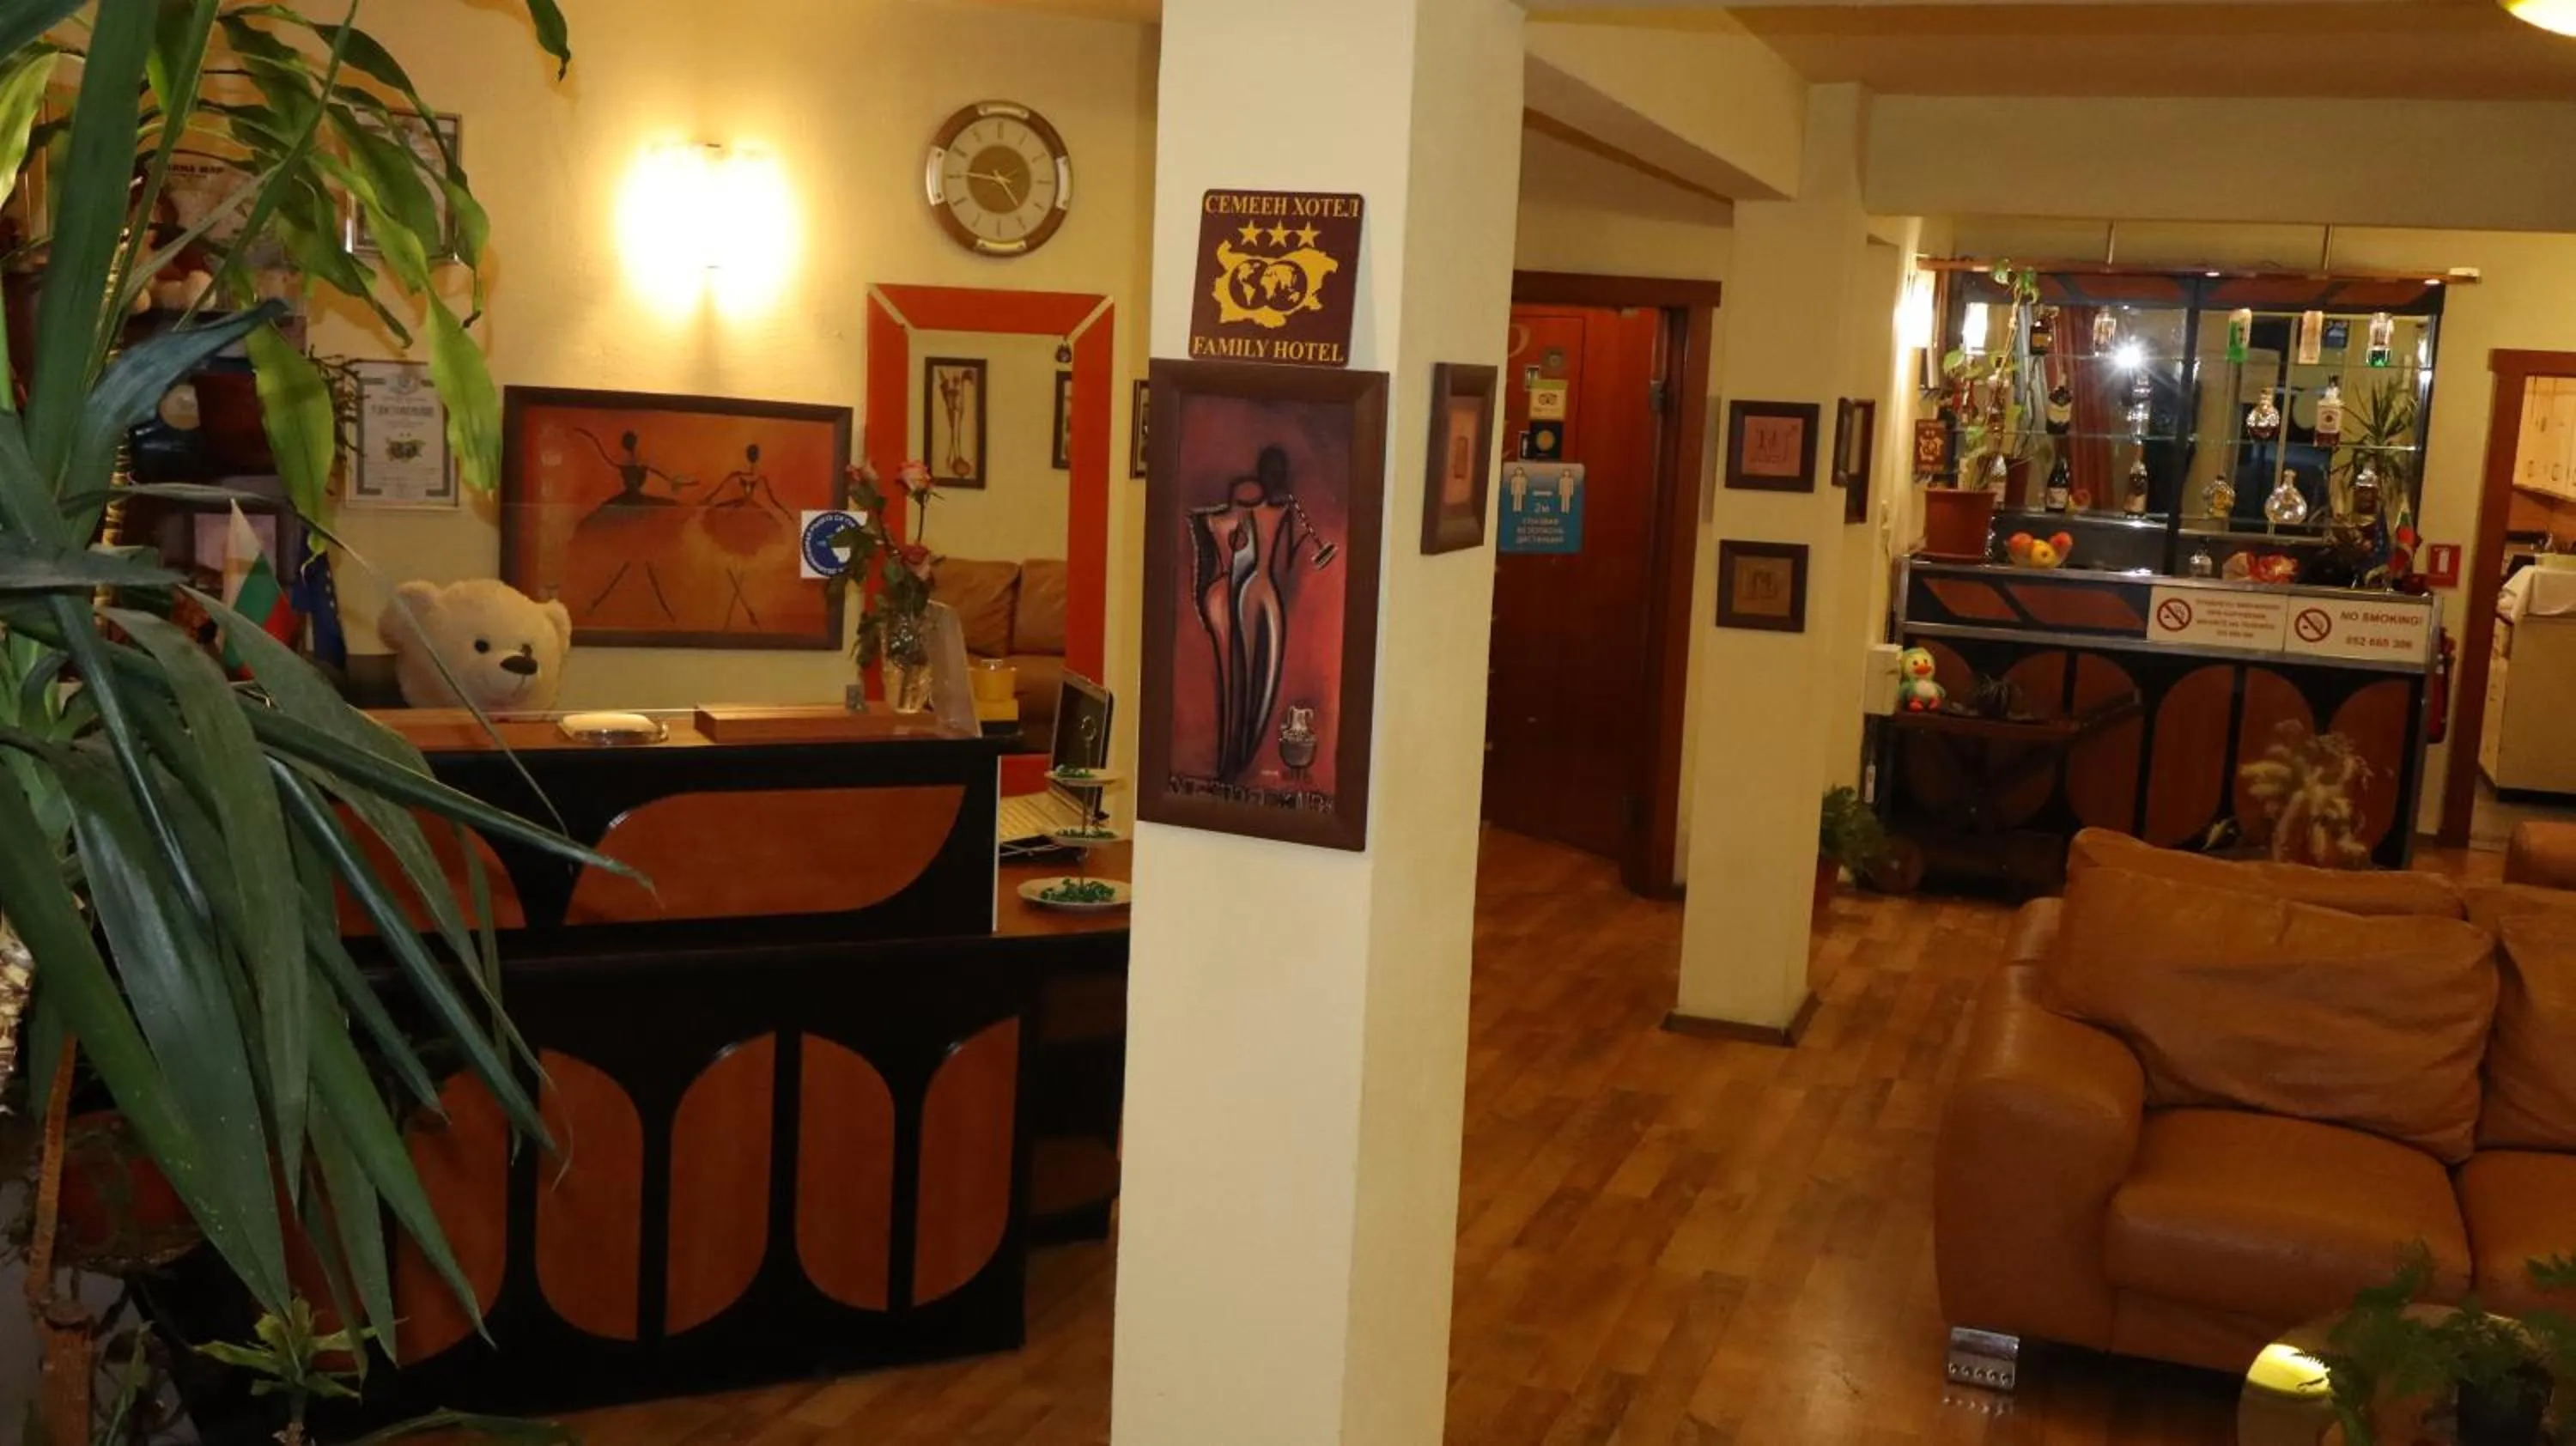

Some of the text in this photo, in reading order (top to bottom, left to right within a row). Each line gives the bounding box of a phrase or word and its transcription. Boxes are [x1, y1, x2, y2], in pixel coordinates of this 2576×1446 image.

[1205, 194, 1361, 218] СЕМЕЕН ХОТЕЛ
[1193, 336, 1345, 362] FAMILY HOTEL
[2340, 611, 2424, 626] NO SMOKING!
